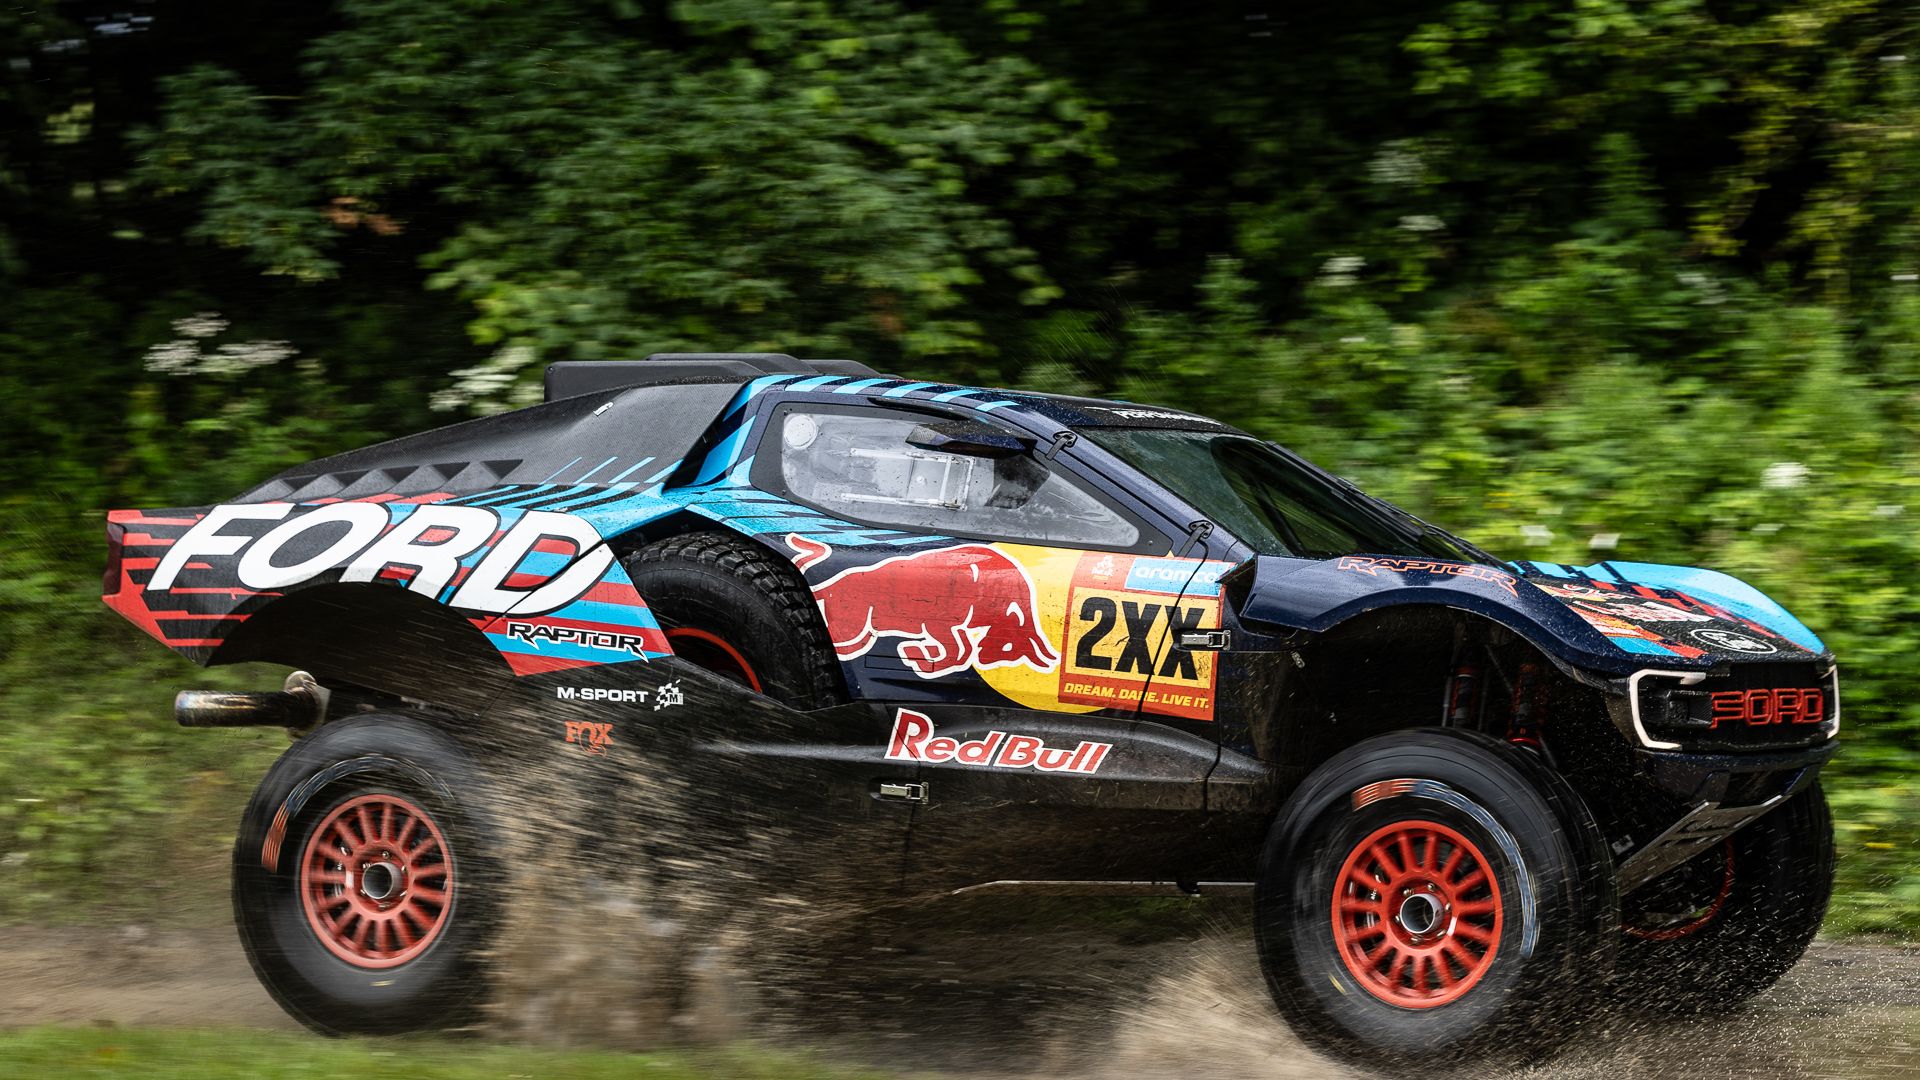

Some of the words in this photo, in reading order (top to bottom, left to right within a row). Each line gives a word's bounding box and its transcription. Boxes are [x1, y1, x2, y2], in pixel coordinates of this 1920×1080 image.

[147, 502, 616, 617] FORD
[1135, 565, 1217, 584] aramco
[1338, 555, 1519, 598] RAPTOR
[507, 621, 649, 663] RAPTOR
[1075, 596, 1205, 680] 2XX
[557, 686, 649, 703] M-SPORT
[1063, 682, 1116, 698] DREAM.
[1161, 693, 1193, 707] LIVE
[1193, 697, 1210, 709] IT.
[1710, 688, 1823, 729] FORD
[565, 720, 614, 748] FOX
[887, 710, 1003, 766] Red
[995, 736, 1112, 774] Bull
